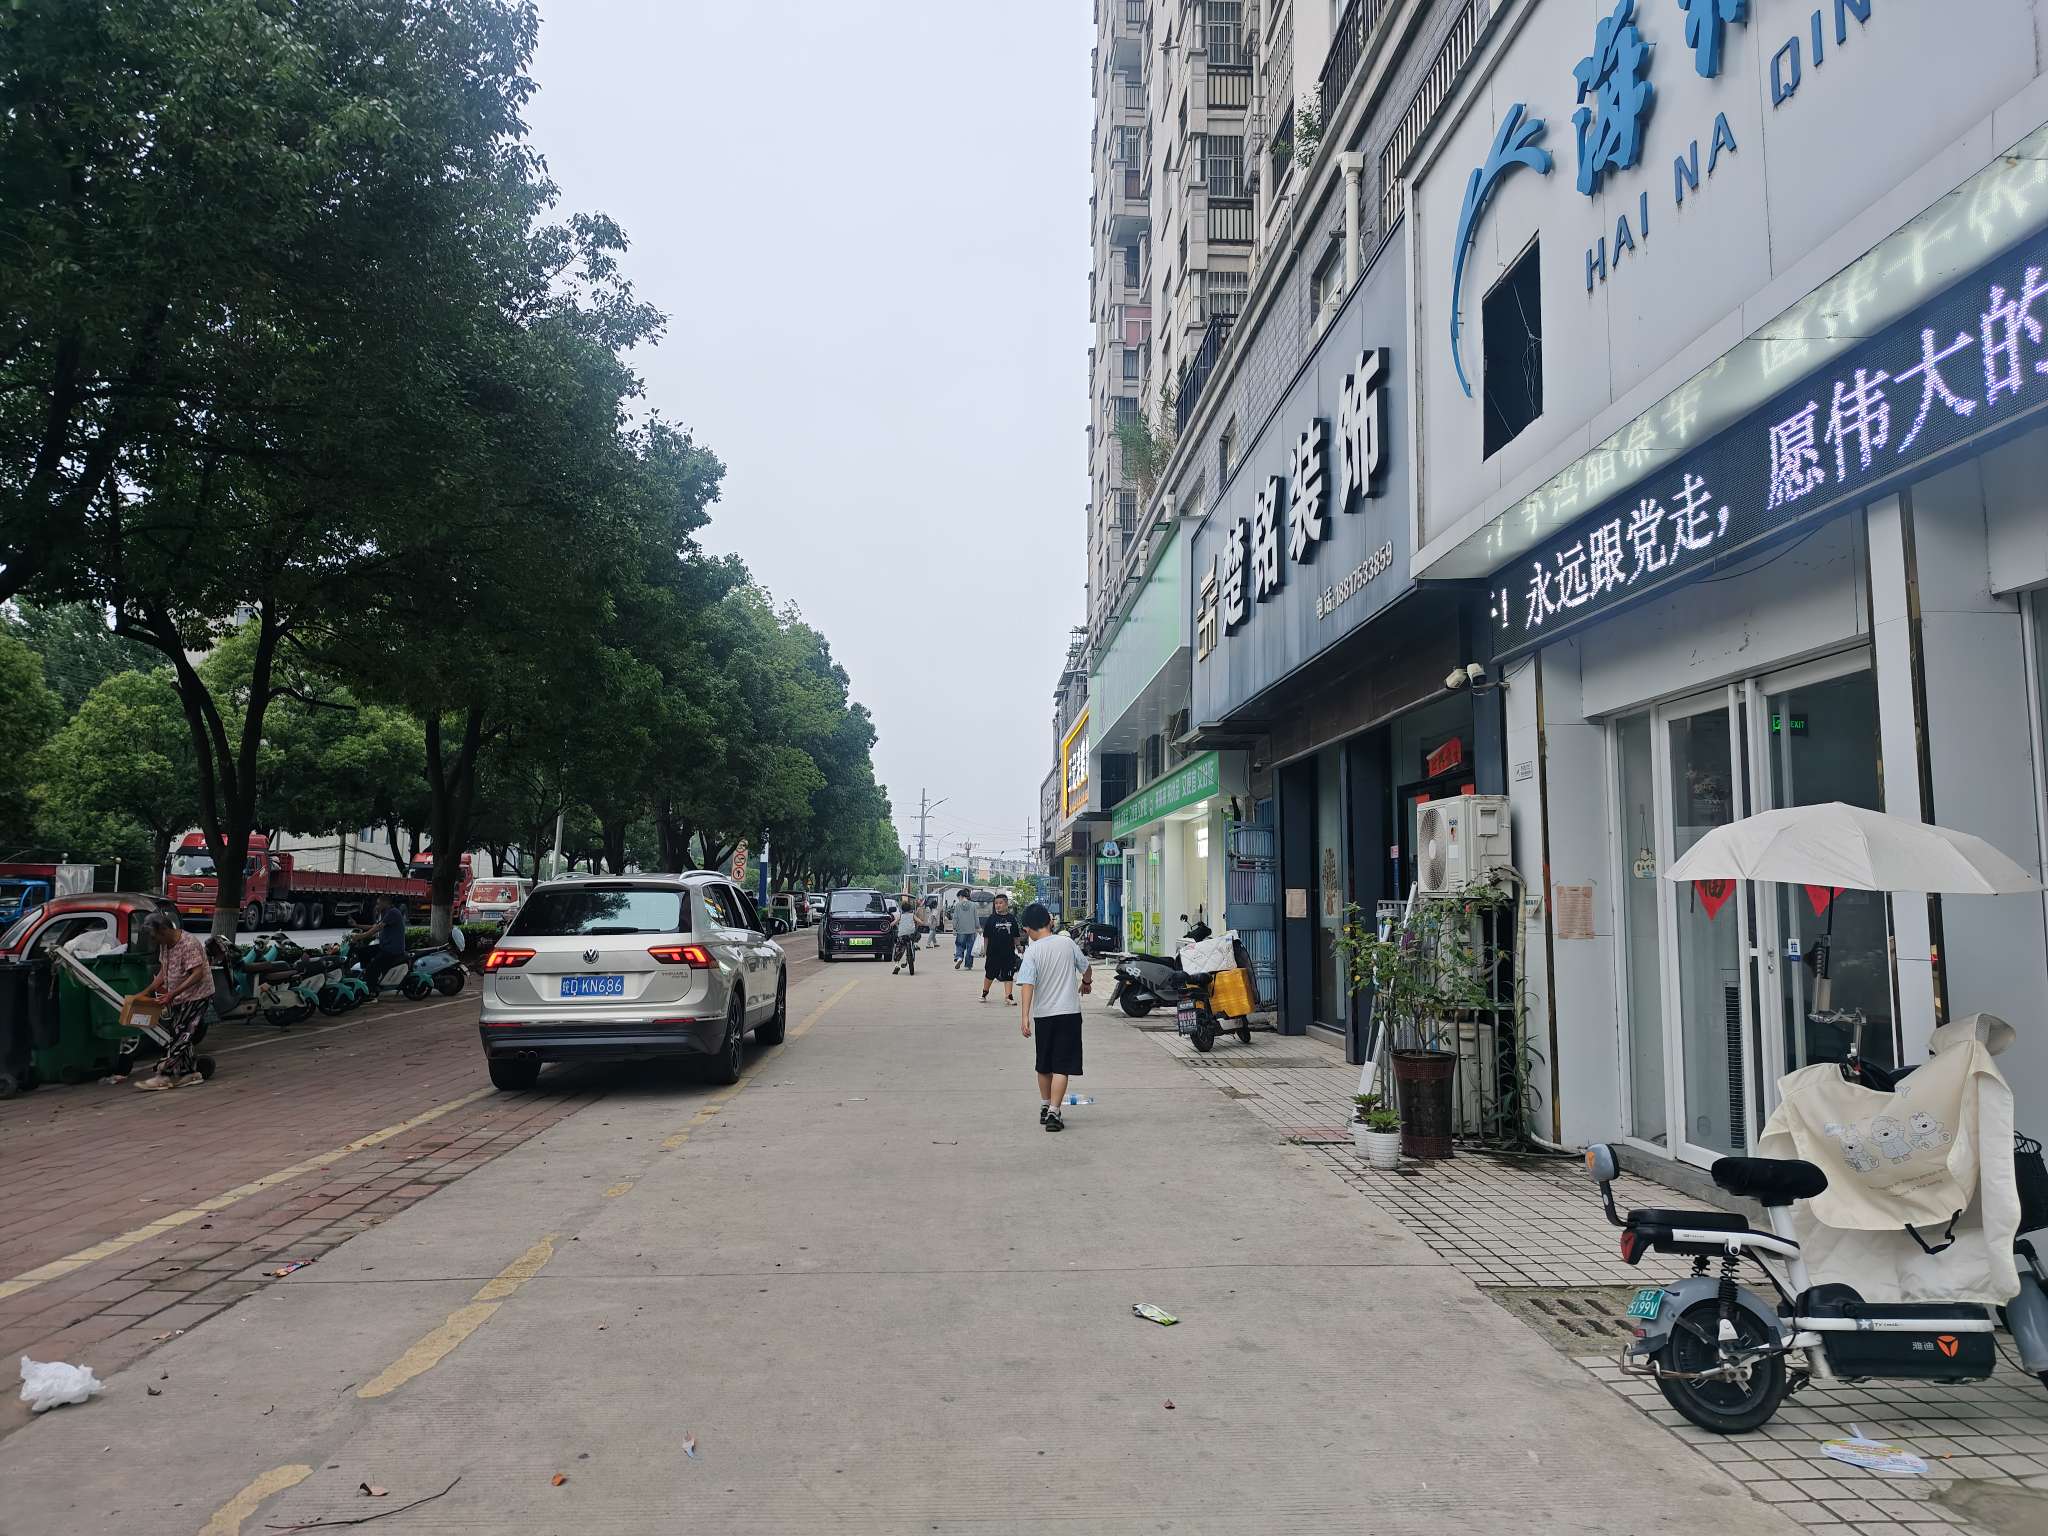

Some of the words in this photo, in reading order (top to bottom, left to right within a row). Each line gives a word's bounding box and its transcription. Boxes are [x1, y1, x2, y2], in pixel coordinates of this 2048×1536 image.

[1585, 191, 1648, 290] HAI
[1673, 112, 1736, 204] NA
[1223, 347, 1390, 637] 楚铭装饰
[1790, 720, 1805, 729] EXIT
[581, 978, 622, 993] KN686
